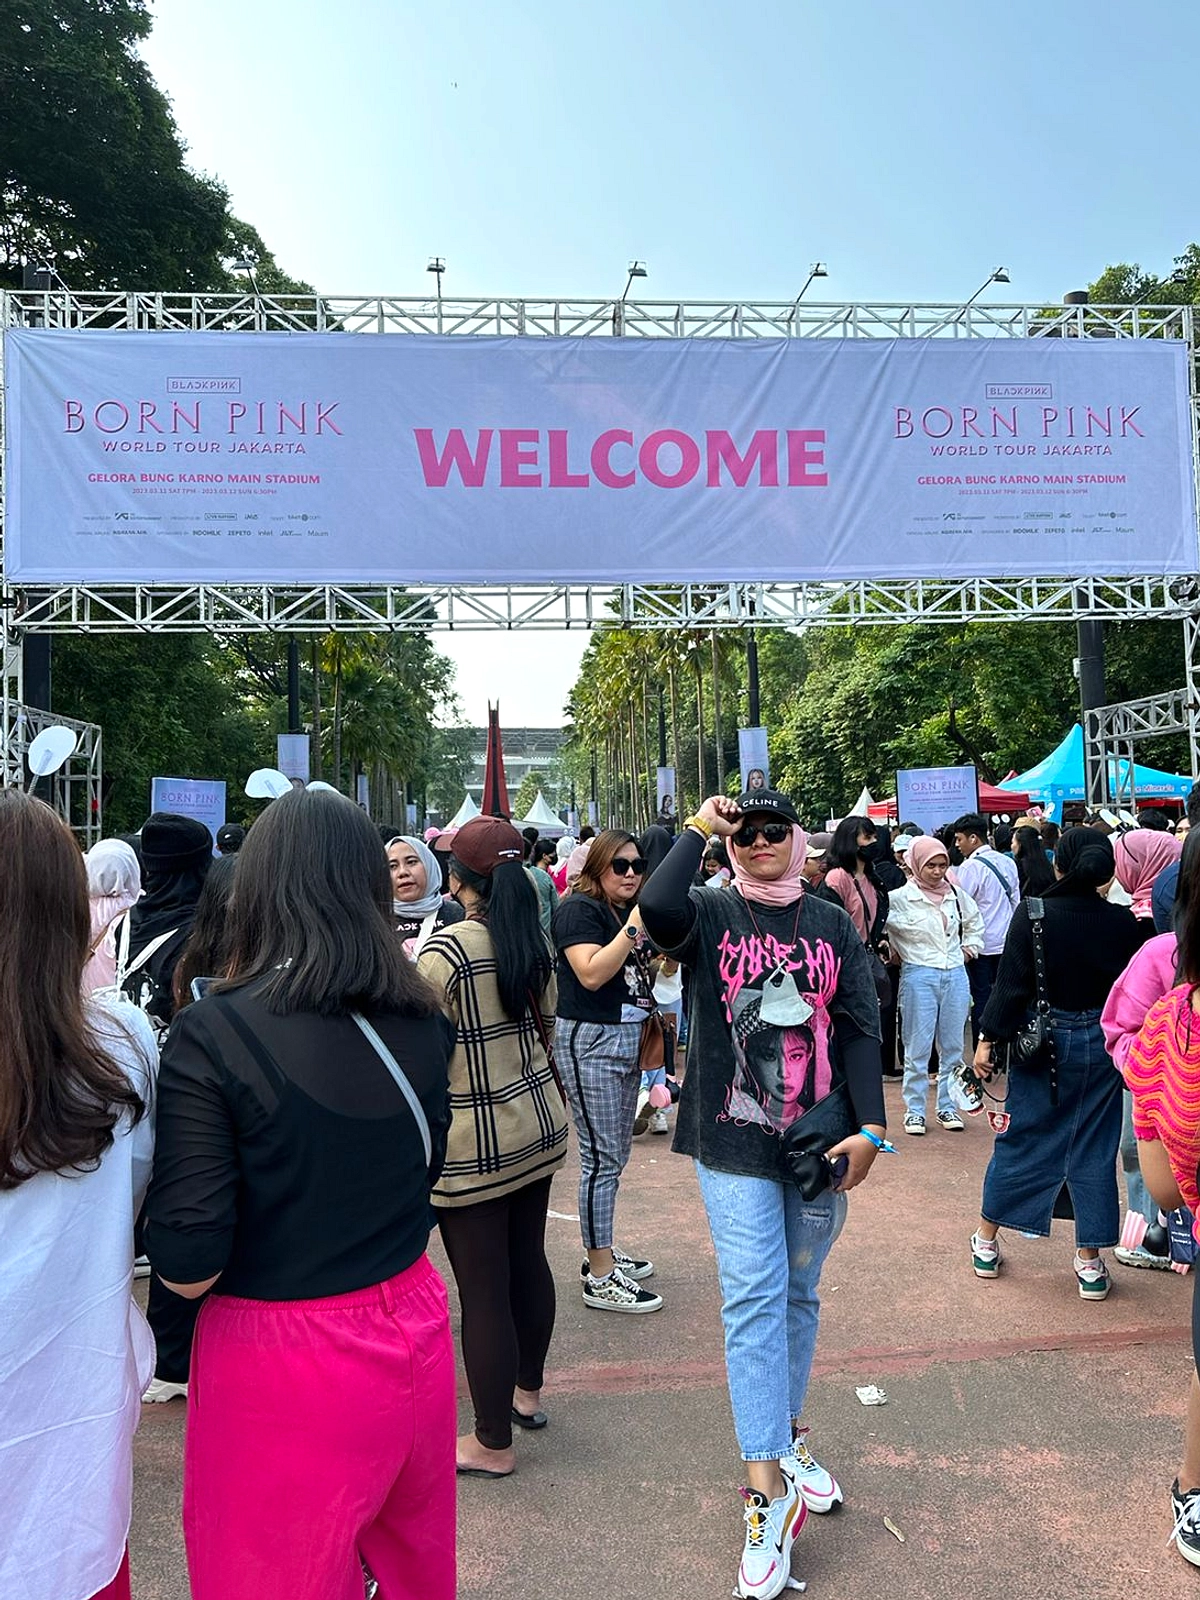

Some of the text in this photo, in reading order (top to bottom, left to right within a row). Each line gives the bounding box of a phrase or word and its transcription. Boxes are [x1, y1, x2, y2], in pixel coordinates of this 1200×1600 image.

[171, 380, 237, 390] BLACKPINK
[990, 386, 1048, 396] BLACKPINK
[63, 400, 344, 436] BORN PINK
[893, 405, 1145, 439] BORN PINK
[102, 441, 307, 454] WORLD TOUR JAKARTA
[930, 444, 1113, 456] WORLD TOUR JAKARTA
[412, 428, 828, 489] WELCOME
[88, 473, 321, 485] GELORA BUNG KARNO MAIN STADIUM
[917, 474, 1126, 485] GELORA BUNG KARNO MAIN STADIUM
[904, 780, 970, 792] BORN PINK
[161, 792, 221, 804] BORN PINK
[742, 798, 779, 808] CELINE
